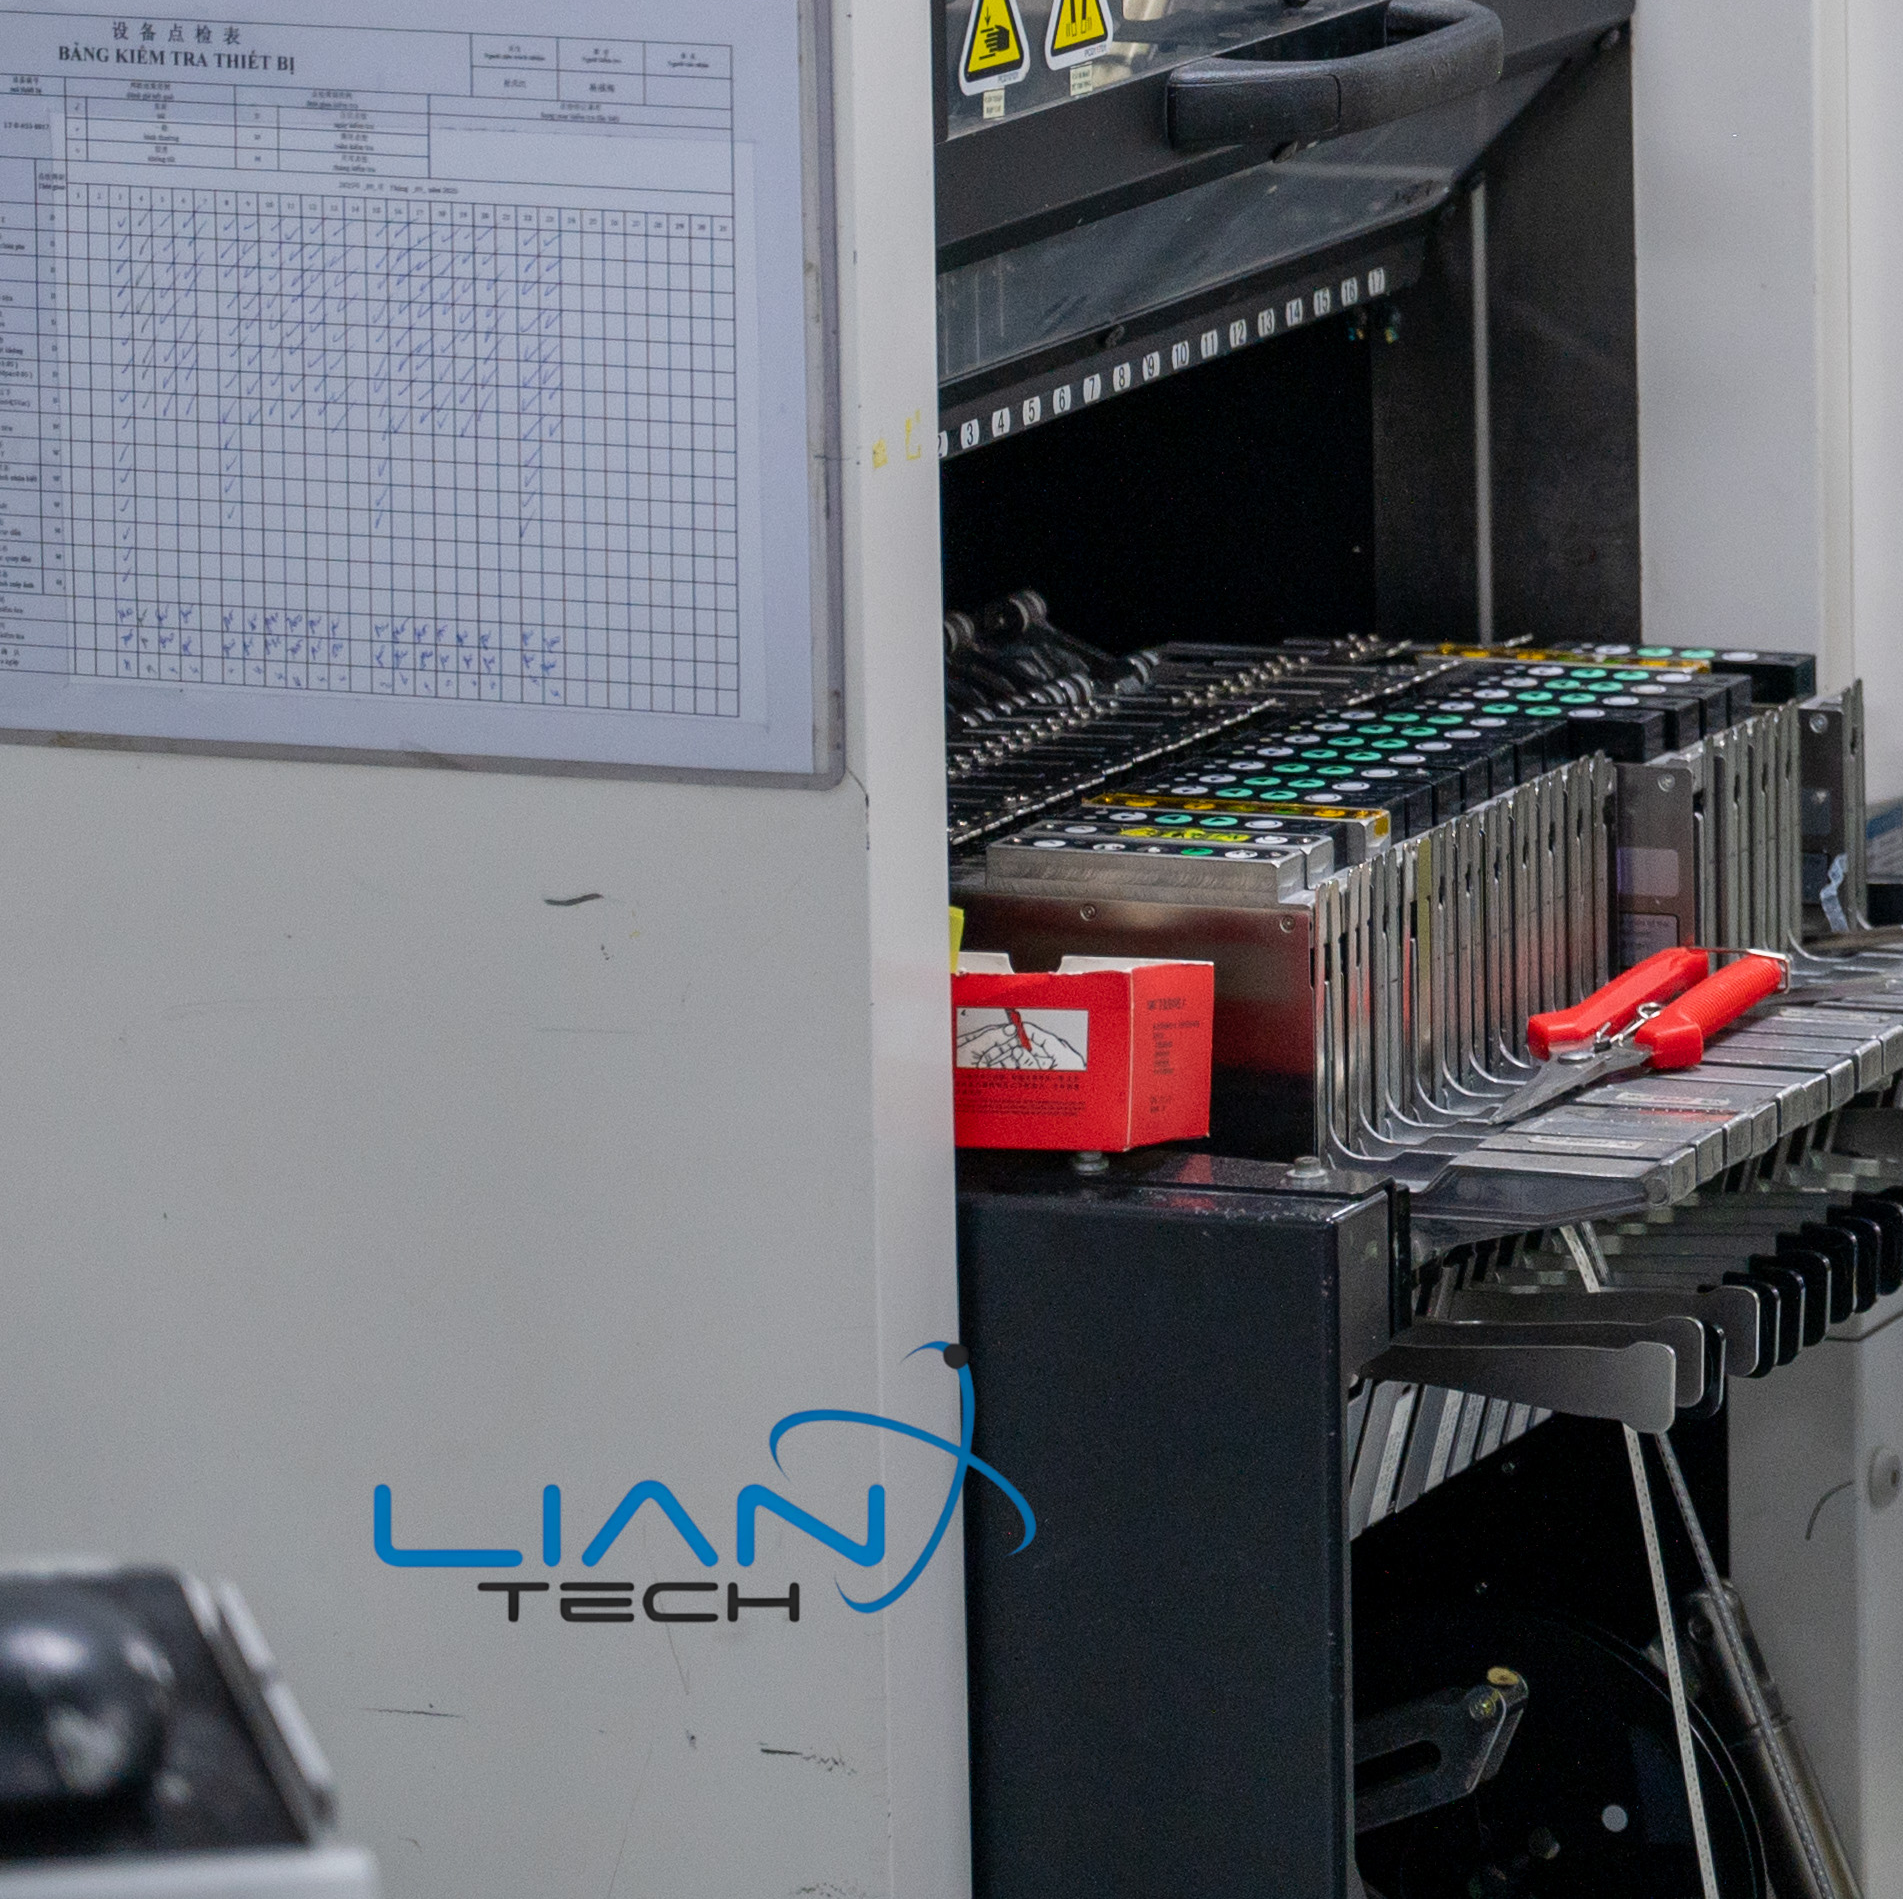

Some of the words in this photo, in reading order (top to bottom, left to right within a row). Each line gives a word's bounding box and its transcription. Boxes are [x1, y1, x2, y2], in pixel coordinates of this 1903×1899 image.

[58, 41, 109, 63] BẢNG
[173, 50, 208, 68] TRA
[213, 49, 272, 71] THIẾT
[276, 55, 295, 75] BỊ
[967, 424, 973, 445] 3
[998, 411, 1005, 433] 4
[1028, 400, 1035, 421] 5
[1059, 389, 1066, 410] 6
[1089, 377, 1096, 399] 7
[1119, 366, 1126, 388] 8
[1148, 355, 1154, 377] 9
[1175, 343, 1187, 365] 10
[1205, 333, 1215, 355] 11
[1233, 322, 1245, 344] 12
[1262, 311, 1273, 333] 13
[1289, 300, 1301, 323] 14
[1318, 290, 1329, 312] 15
